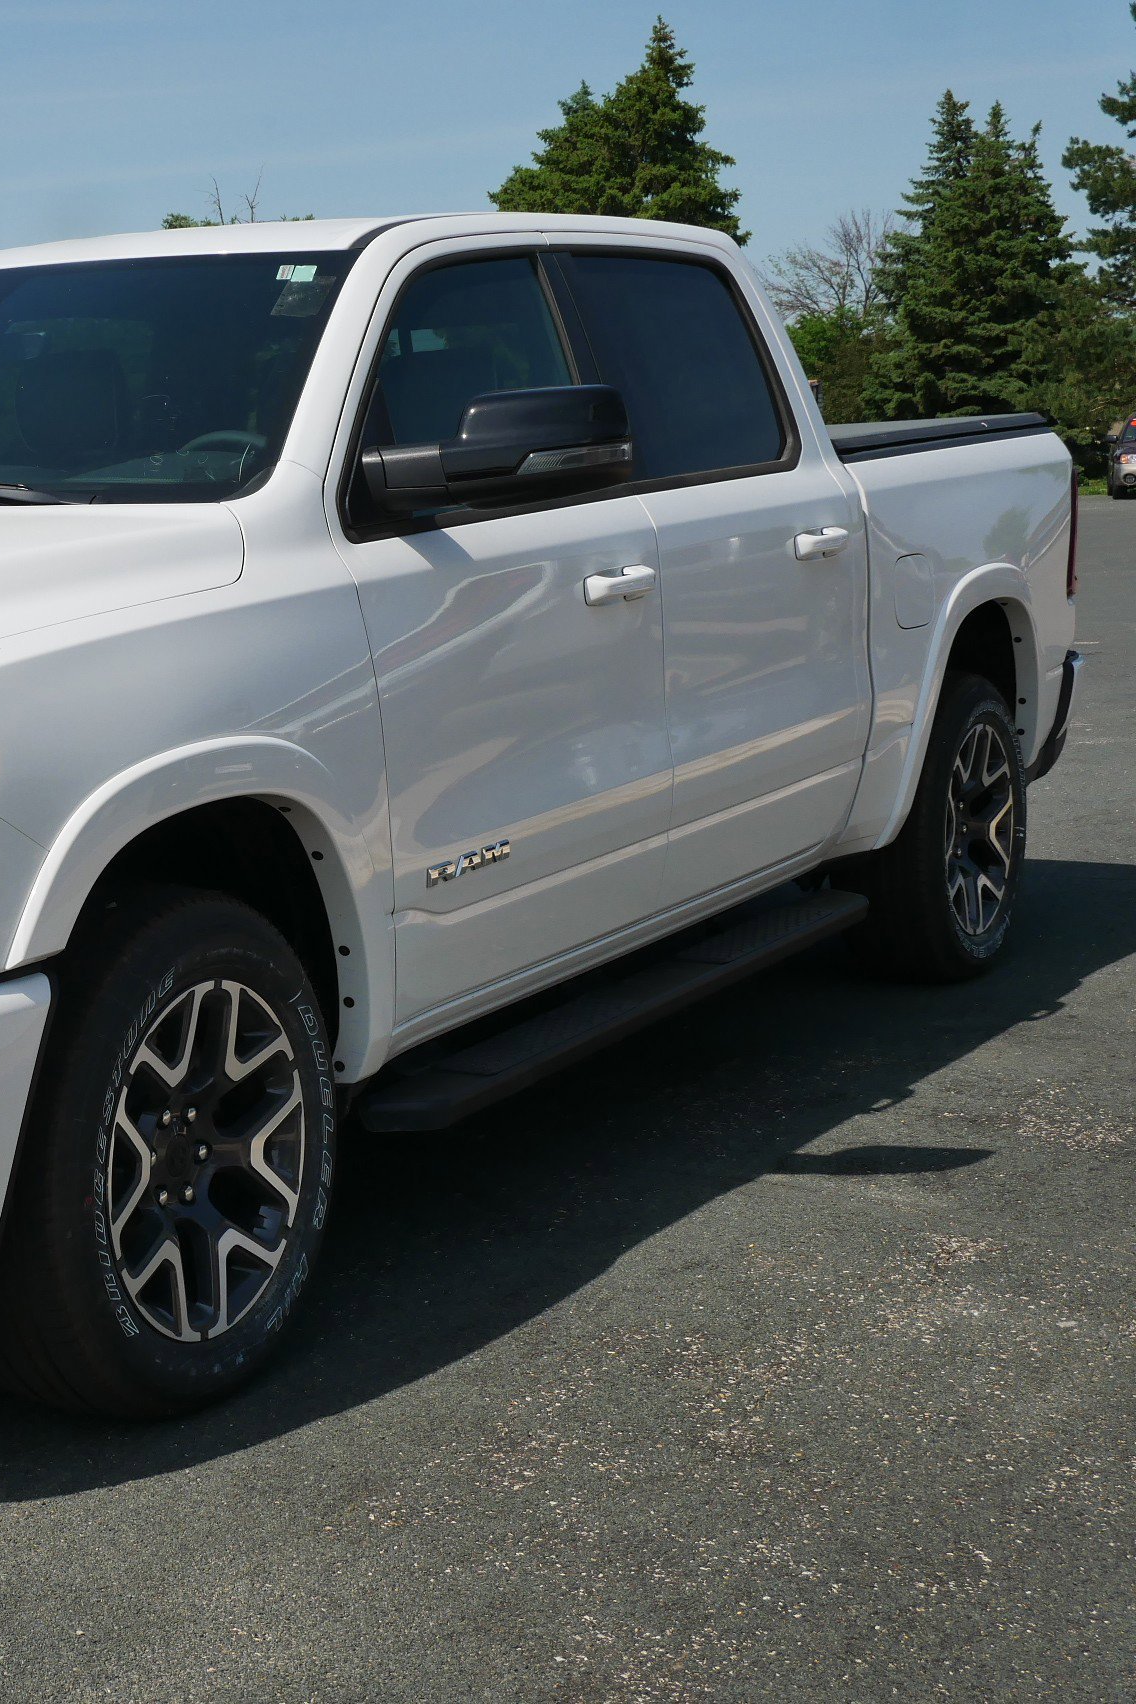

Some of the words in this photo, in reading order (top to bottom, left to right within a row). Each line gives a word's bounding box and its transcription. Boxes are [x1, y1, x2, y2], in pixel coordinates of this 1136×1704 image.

[426, 838, 511, 889] RAM
[94, 966, 176, 1338] BRIDGESTONE
[297, 1004, 335, 1231] DUELER
